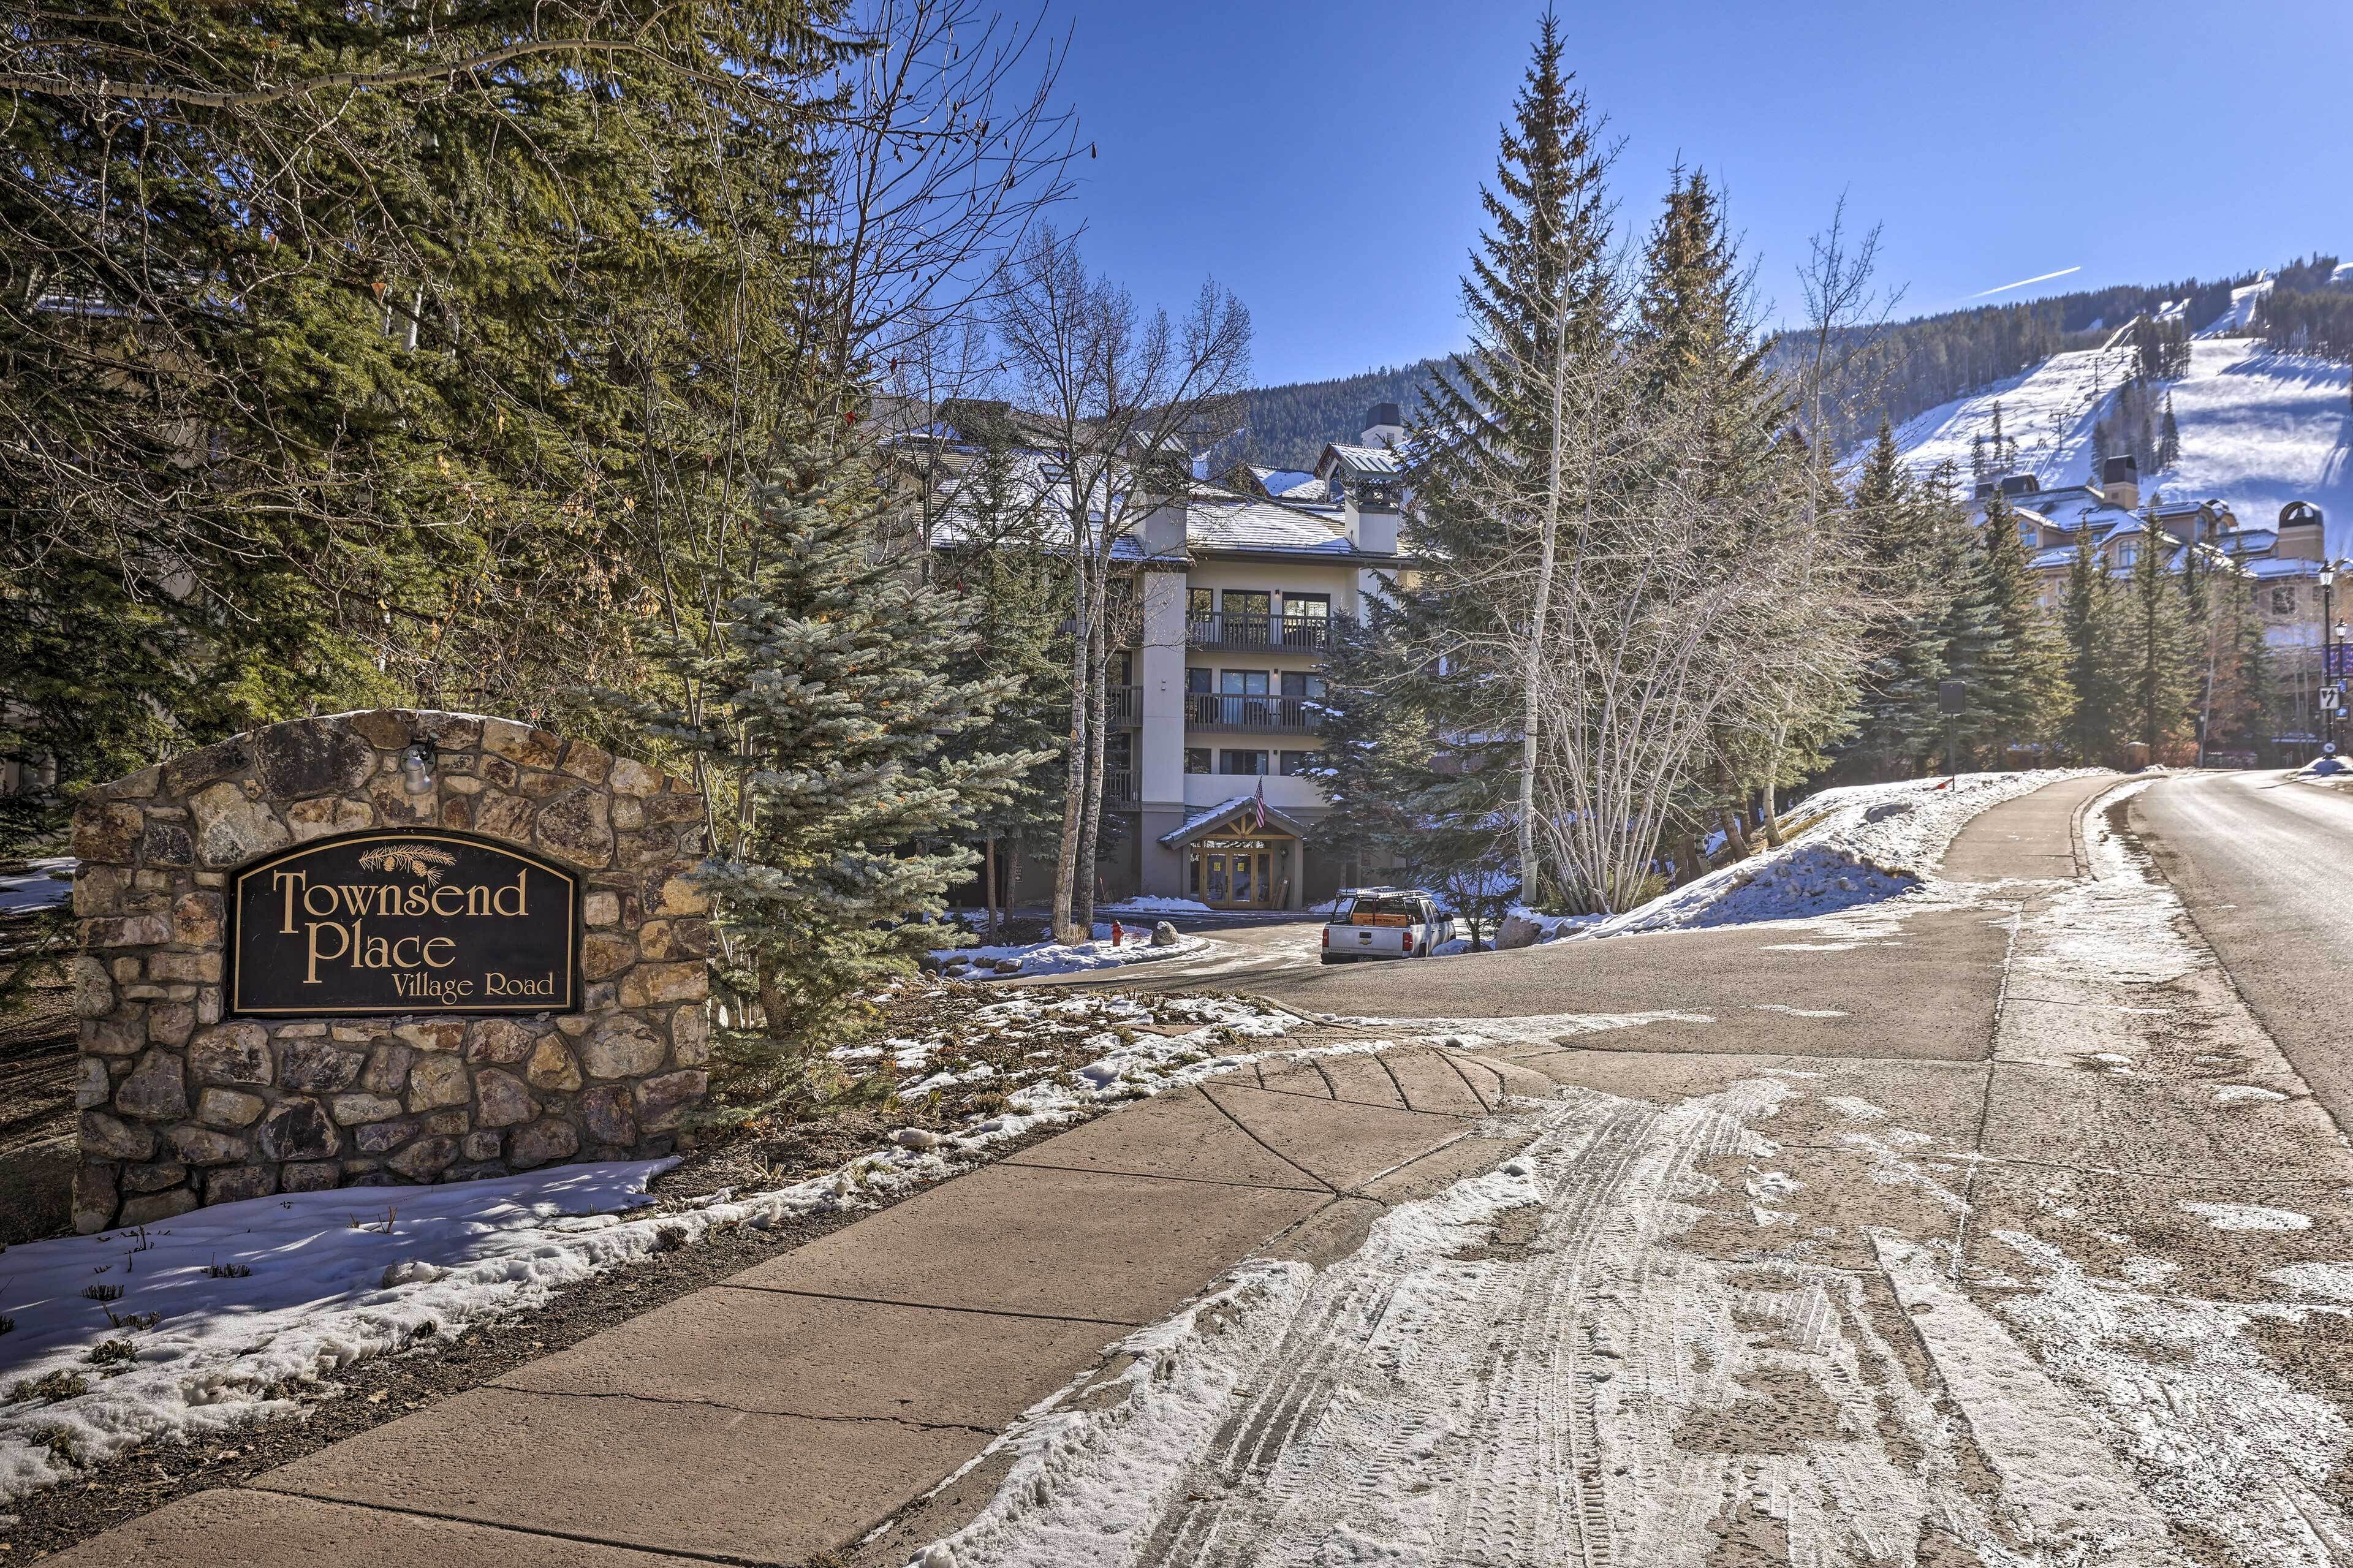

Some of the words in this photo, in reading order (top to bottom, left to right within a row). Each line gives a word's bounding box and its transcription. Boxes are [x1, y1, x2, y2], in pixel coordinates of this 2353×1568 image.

[273, 868, 529, 934] Townsend
[303, 918, 457, 983] Place
[391, 972, 474, 1006] Village
[483, 969, 555, 996] Road
